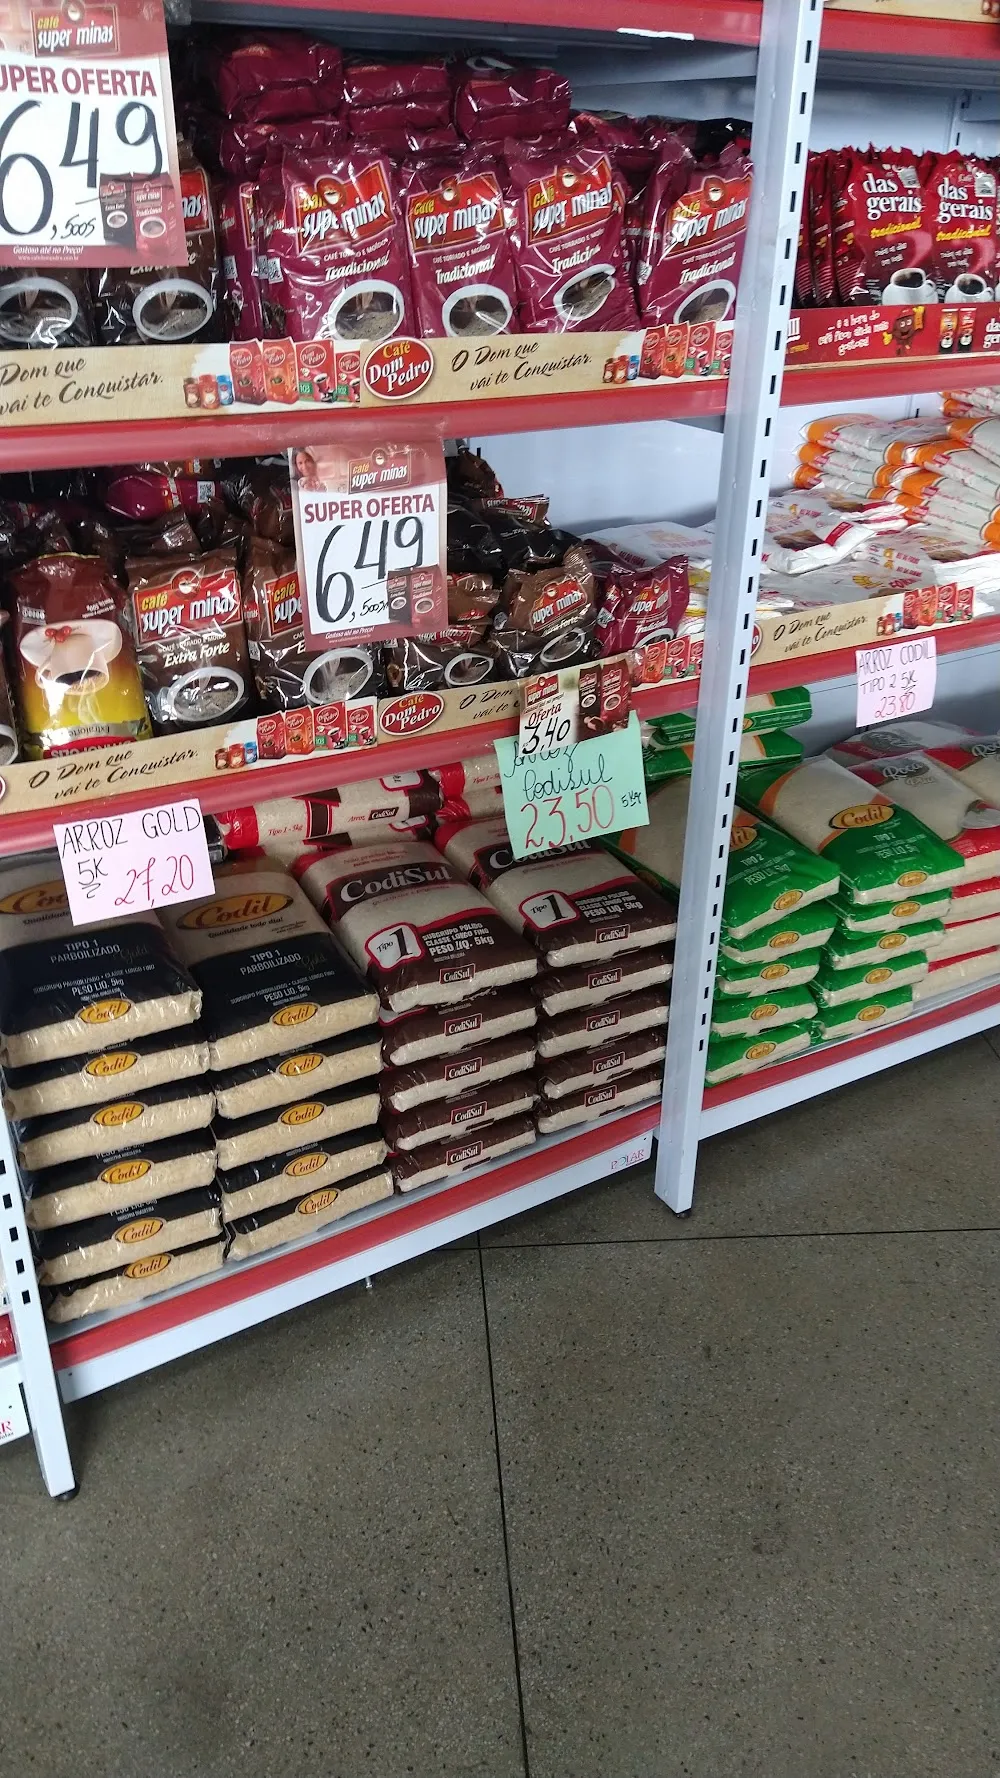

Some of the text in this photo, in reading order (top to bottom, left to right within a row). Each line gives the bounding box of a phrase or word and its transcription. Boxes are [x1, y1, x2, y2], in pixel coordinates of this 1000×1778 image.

[38, 20, 113, 52] super minas
[0, 65, 157, 97] UPER OFERTA
[862, 173, 898, 193] das
[937, 177, 968, 200] das
[533, 182, 612, 233] super minas
[867, 190, 922, 220] gerais
[938, 199, 993, 223] gerais
[671, 198, 748, 246] super minas
[870, 216, 922, 239] tradicional
[325, 250, 389, 281] Tradicional
[436, 254, 496, 284] Tradicional
[679, 252, 736, 284] Tradicional
[383, 342, 411, 359] Café
[451, 341, 540, 372] O Dom que
[0, 358, 86, 386] Dom que
[368, 357, 404, 385] Dom
[387, 359, 430, 393] Pedro
[470, 374, 492, 391] vai
[494, 371, 509, 384] te
[300, 384, 310, 393] 103
[34, 392, 52, 410] te
[352, 464, 407, 490] super minas
[305, 494, 435, 523] SUPER OFERTA
[141, 592, 168, 612] café
[274, 581, 296, 603] café
[142, 604, 184, 634] super
[190, 590, 235, 620] minas
[532, 591, 583, 624] super minas
[773, 612, 832, 641] O Dom que
[784, 640, 800, 653] vai
[801, 635, 812, 645] te
[163, 642, 230, 668] Extra Forte
[858, 649, 893, 675] ARROZ
[860, 677, 884, 694] TIPO
[889, 674, 896, 688] 2
[398, 694, 424, 708] Café
[473, 702, 509, 719] vai te
[875, 692, 916, 718] 23,80
[384, 705, 417, 728] Dom
[400, 705, 440, 731] Pedro
[529, 702, 561, 726] Oferta
[68, 725, 110, 737] Extraforte
[522, 717, 570, 754] 3,40
[29, 750, 134, 788] O Dom que
[54, 782, 82, 799] vai
[85, 778, 101, 791] te
[349, 808, 398, 823] Arroz CodiSul
[520, 785, 614, 849] 23,50
[841, 806, 885, 827] Codil
[62, 806, 201, 859] ARROZ GOLD
[740, 856, 758, 866] TIPO
[115, 854, 193, 907] 27,20
[340, 865, 453, 903] CodiSul
[607, 890, 630, 898] POLIDO
[195, 898, 271, 927] Codil
[530, 904, 548, 914] Tipo
[543, 894, 568, 922] 1
[579, 901, 602, 911] CLASSE
[602, 898, 623, 906] LONGO
[584, 902, 643, 918] PESO LIQ. 5kg
[207, 924, 249, 939] Qualidade
[250, 920, 267, 928] todo
[268, 916, 283, 925] dia!
[422, 922, 483, 941] SUBGRUPO POLIDO
[425, 927, 489, 947] CLASSE LONGO FINO
[599, 928, 626, 942] CodiSul
[50, 944, 121, 964] PARBOILIZADO
[64, 941, 90, 951] TIPO
[376, 940, 394, 953] Tipo
[388, 927, 413, 961] 1
[429, 943, 454, 956] PESO
[475, 935, 495, 948] 5kg
[240, 952, 301, 976] PARBOILIZADO
[250, 949, 281, 962] TIPO 1
[443, 968, 471, 983] CodiSul
[591, 972, 619, 987] CodiSul
[72, 984, 93, 996] PESO
[111, 978, 124, 987] 5kg
[264, 990, 283, 1002] PESO
[298, 984, 310, 993] 5kg
[87, 1001, 123, 1021] Codil
[280, 1006, 309, 1025] Codil
[448, 1019, 478, 1034] CodiSul
[589, 1015, 617, 1030] CodiSul
[93, 1058, 127, 1075] Codil
[285, 1057, 315, 1074] Codil
[448, 1063, 478, 1078] CodiSul
[595, 1055, 622, 1071] CodiSul
[587, 1089, 613, 1104] CodiSul
[101, 1108, 135, 1126] Codil
[288, 1108, 316, 1124] Codil
[454, 1107, 484, 1122] CodiSul
[450, 1146, 479, 1163] CodiSul
[611, 1149, 644, 1170] POLAR
[109, 1165, 141, 1182] Codil
[292, 1158, 320, 1175] Codil
[304, 1194, 331, 1212] Codil
[122, 1224, 155, 1241] Codil
[131, 1259, 162, 1277] Codil
